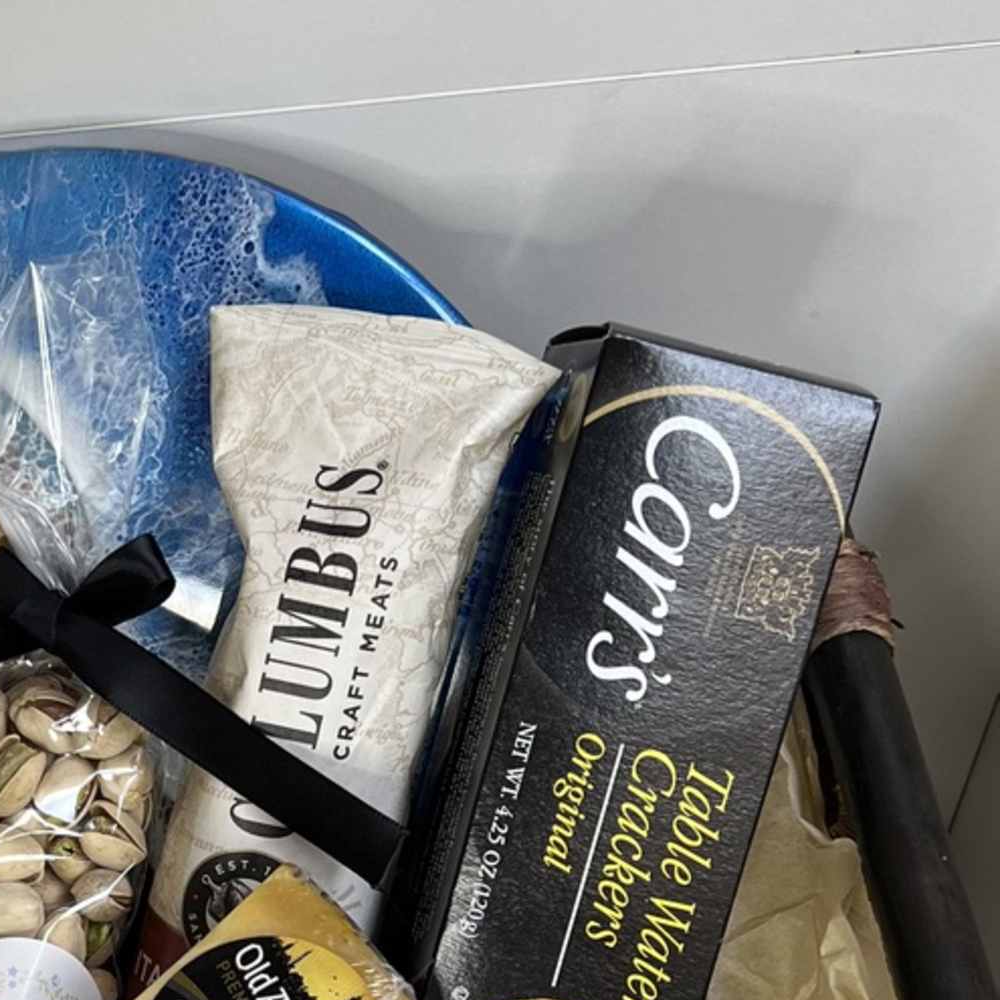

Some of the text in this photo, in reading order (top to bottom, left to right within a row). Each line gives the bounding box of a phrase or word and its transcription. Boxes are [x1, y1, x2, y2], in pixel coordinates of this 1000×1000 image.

[584, 416, 740, 702] Carr's
[332, 554, 400, 762] CRAFT MEATS
[499, 766, 526, 800] WT.
[511, 721, 538, 763] NET
[487, 805, 514, 847] 4.25
[542, 732, 607, 876] Original
[584, 748, 678, 949] Crackers
[661, 761, 735, 888] Table
[479, 848, 501, 880] OZ.
[234, 943, 281, 996] Old
